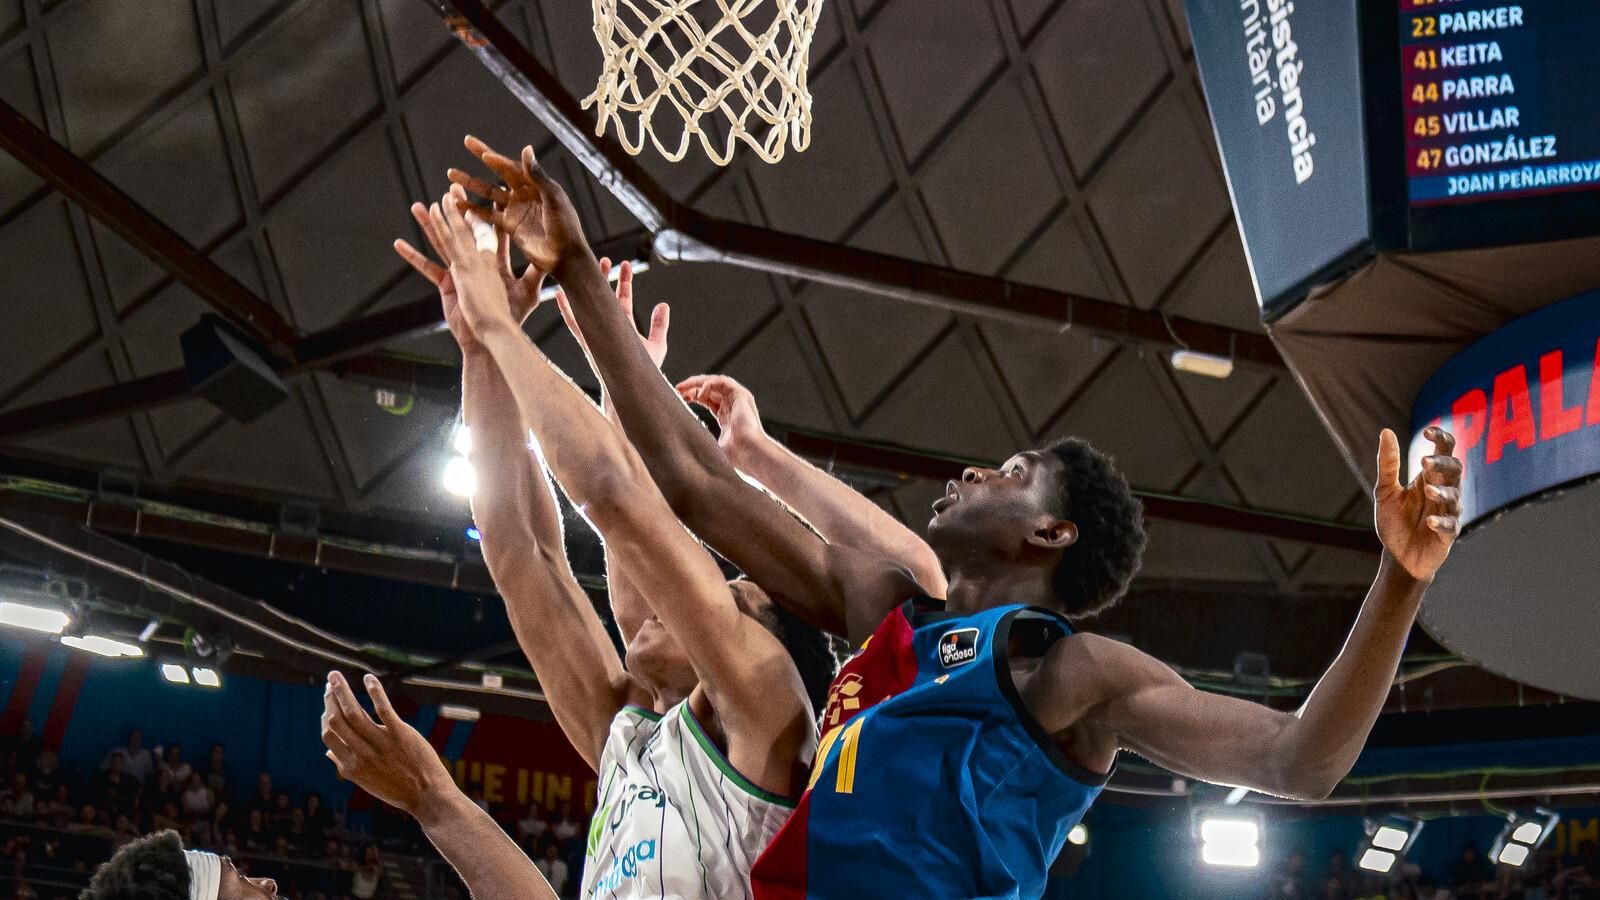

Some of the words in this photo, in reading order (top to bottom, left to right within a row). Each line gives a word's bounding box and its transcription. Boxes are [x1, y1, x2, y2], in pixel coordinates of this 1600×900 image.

[1412, 17, 1436, 37] 22
[1439, 6, 1523, 34] PARKER
[1414, 50, 1437, 70] 41
[1440, 41, 1502, 68] KEITA
[1412, 82, 1439, 103] 44
[1442, 73, 1514, 100] PARRA
[1414, 116, 1440, 136] 45
[1443, 106, 1519, 134] VILLAR
[1416, 149, 1442, 169] 47
[1445, 134, 1557, 167] GONZÁLEZ
[1448, 175, 1495, 195] JOAN
[1452, 336, 1600, 481] PAL
[440, 756, 507, 802] UE
